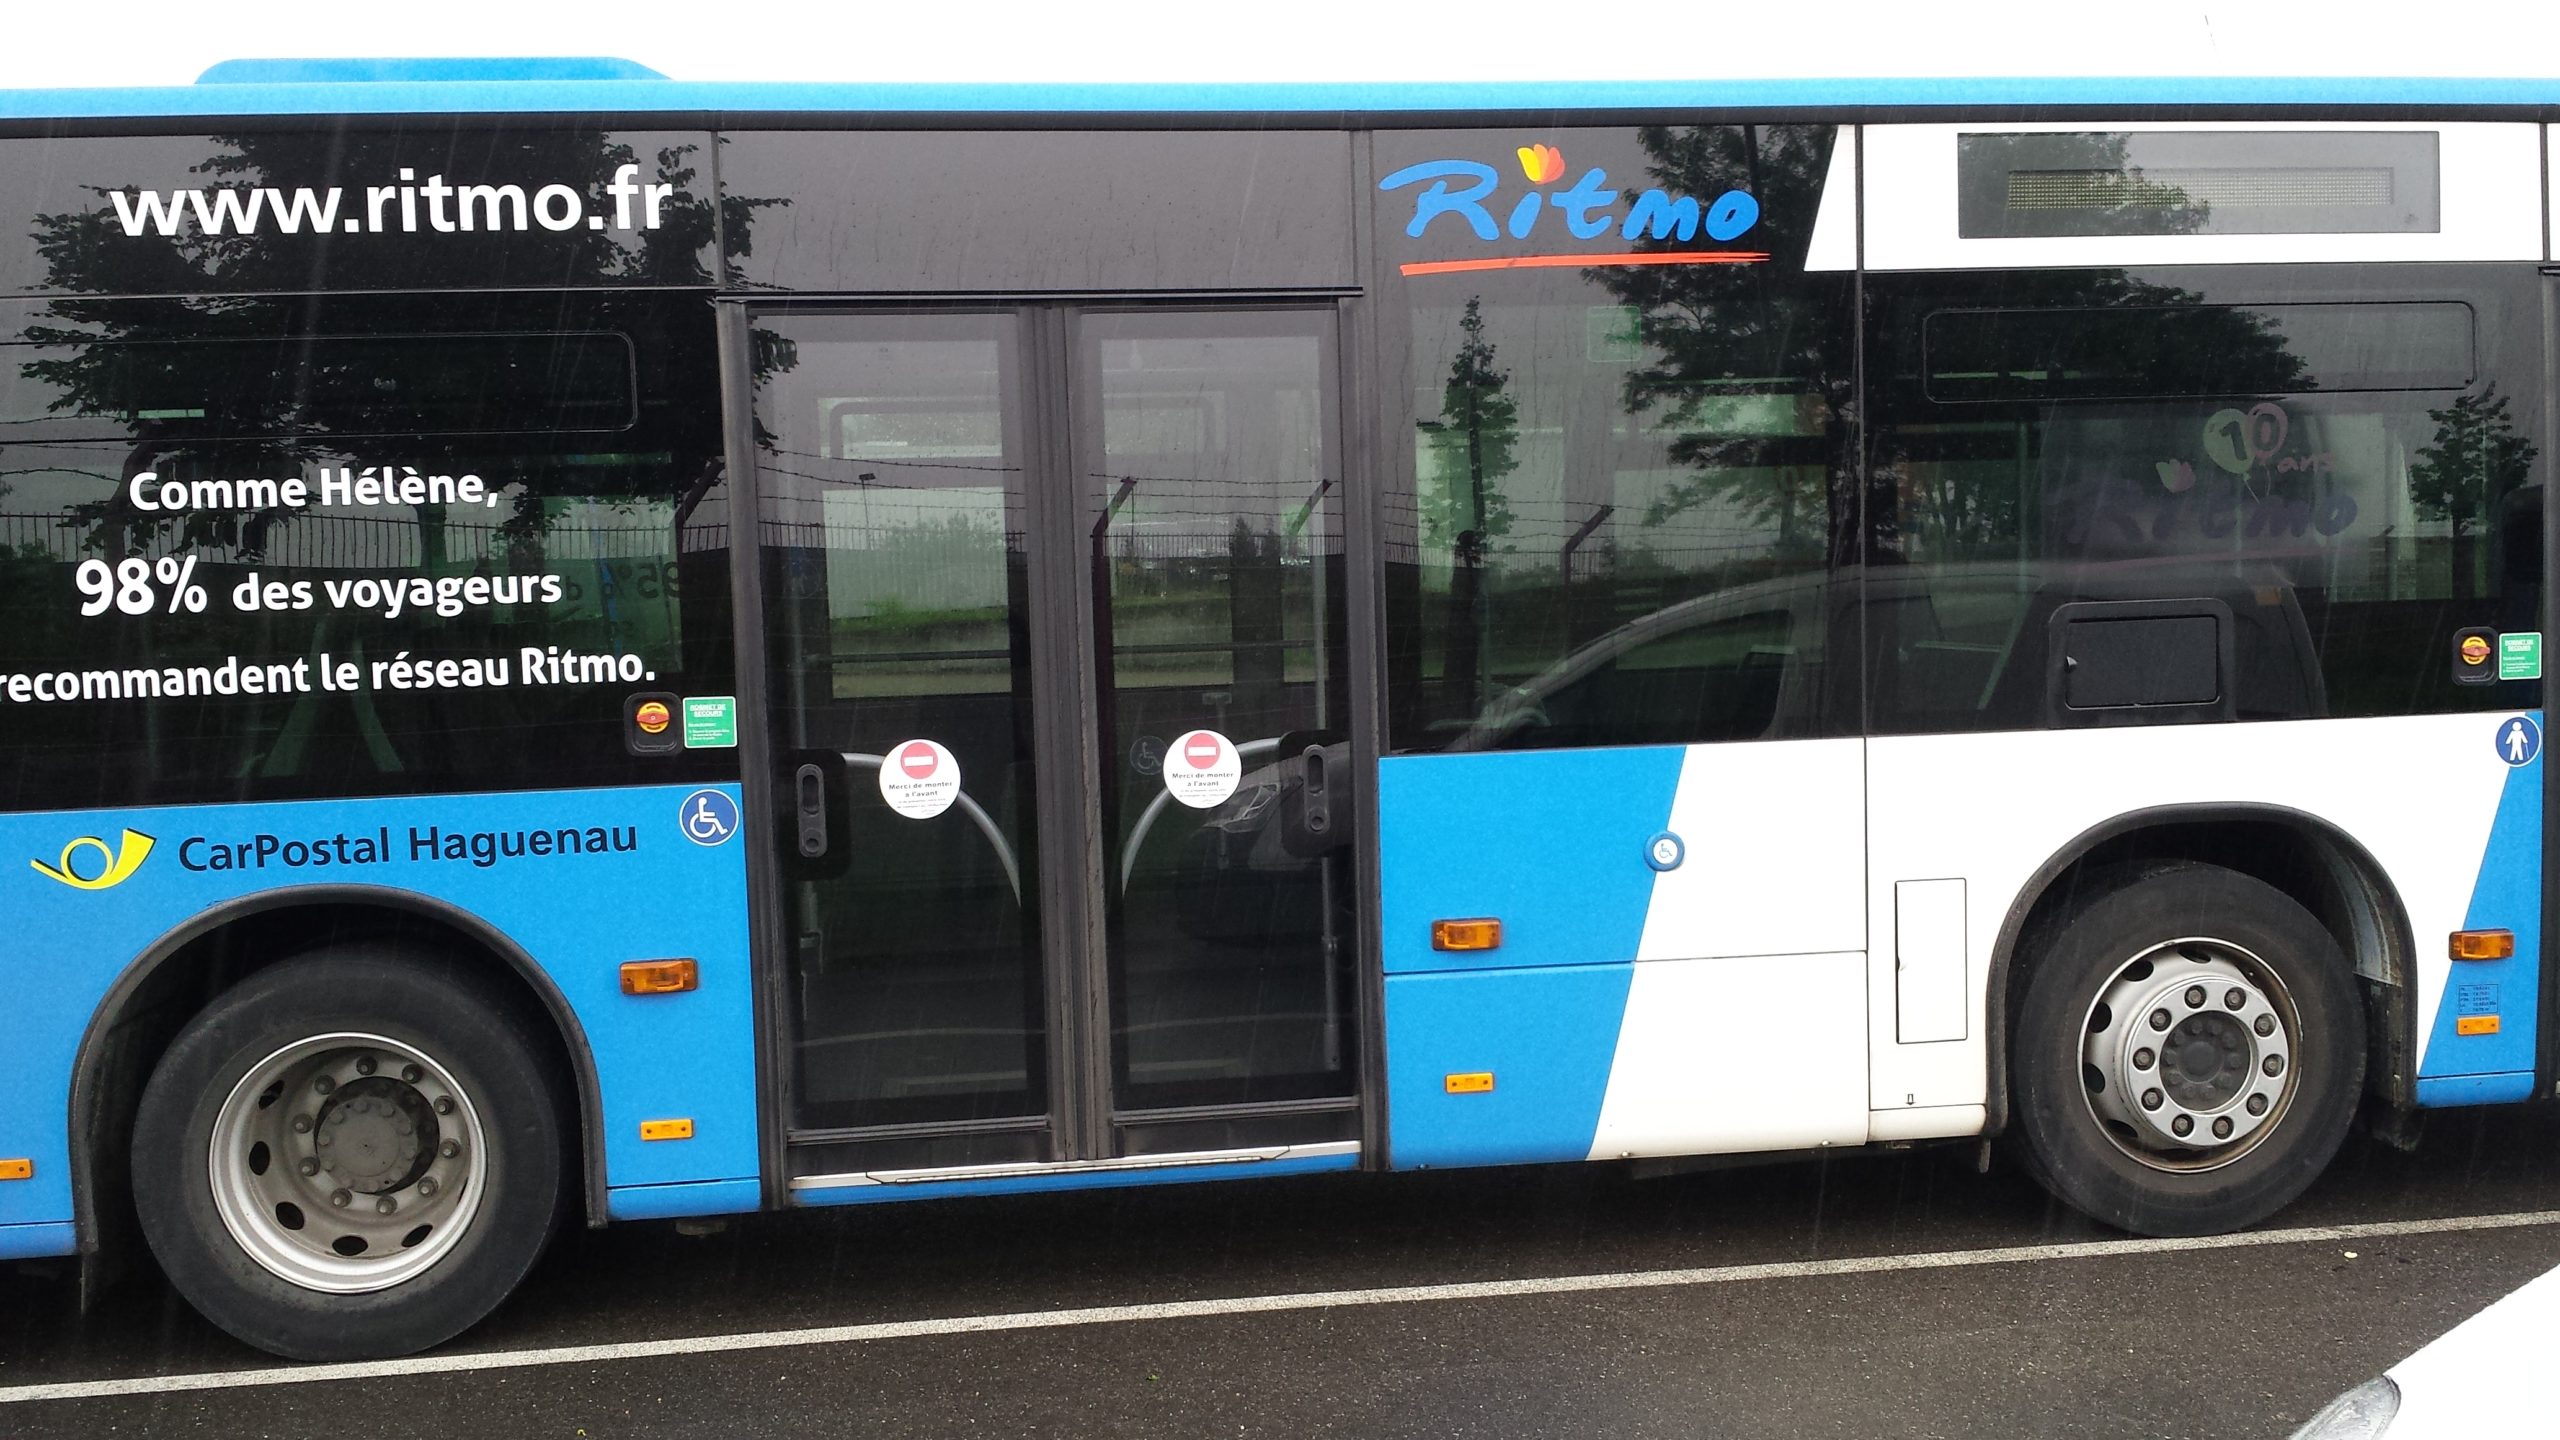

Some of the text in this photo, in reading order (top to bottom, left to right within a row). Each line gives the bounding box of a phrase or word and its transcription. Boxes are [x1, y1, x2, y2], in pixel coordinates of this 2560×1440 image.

[109, 164, 672, 236] www.ritmo.fr
[1380, 144, 1759, 242] Ritmo
[130, 466, 498, 511] Comme Hélène,
[76, 554, 208, 617] 98%
[233, 573, 314, 611] des
[324, 575, 562, 619] voyageurs
[321, 654, 360, 691] le
[372, 651, 509, 690] réseau
[521, 645, 656, 686] Ritmo.
[179, 826, 637, 872] CarPostal Haguenau
